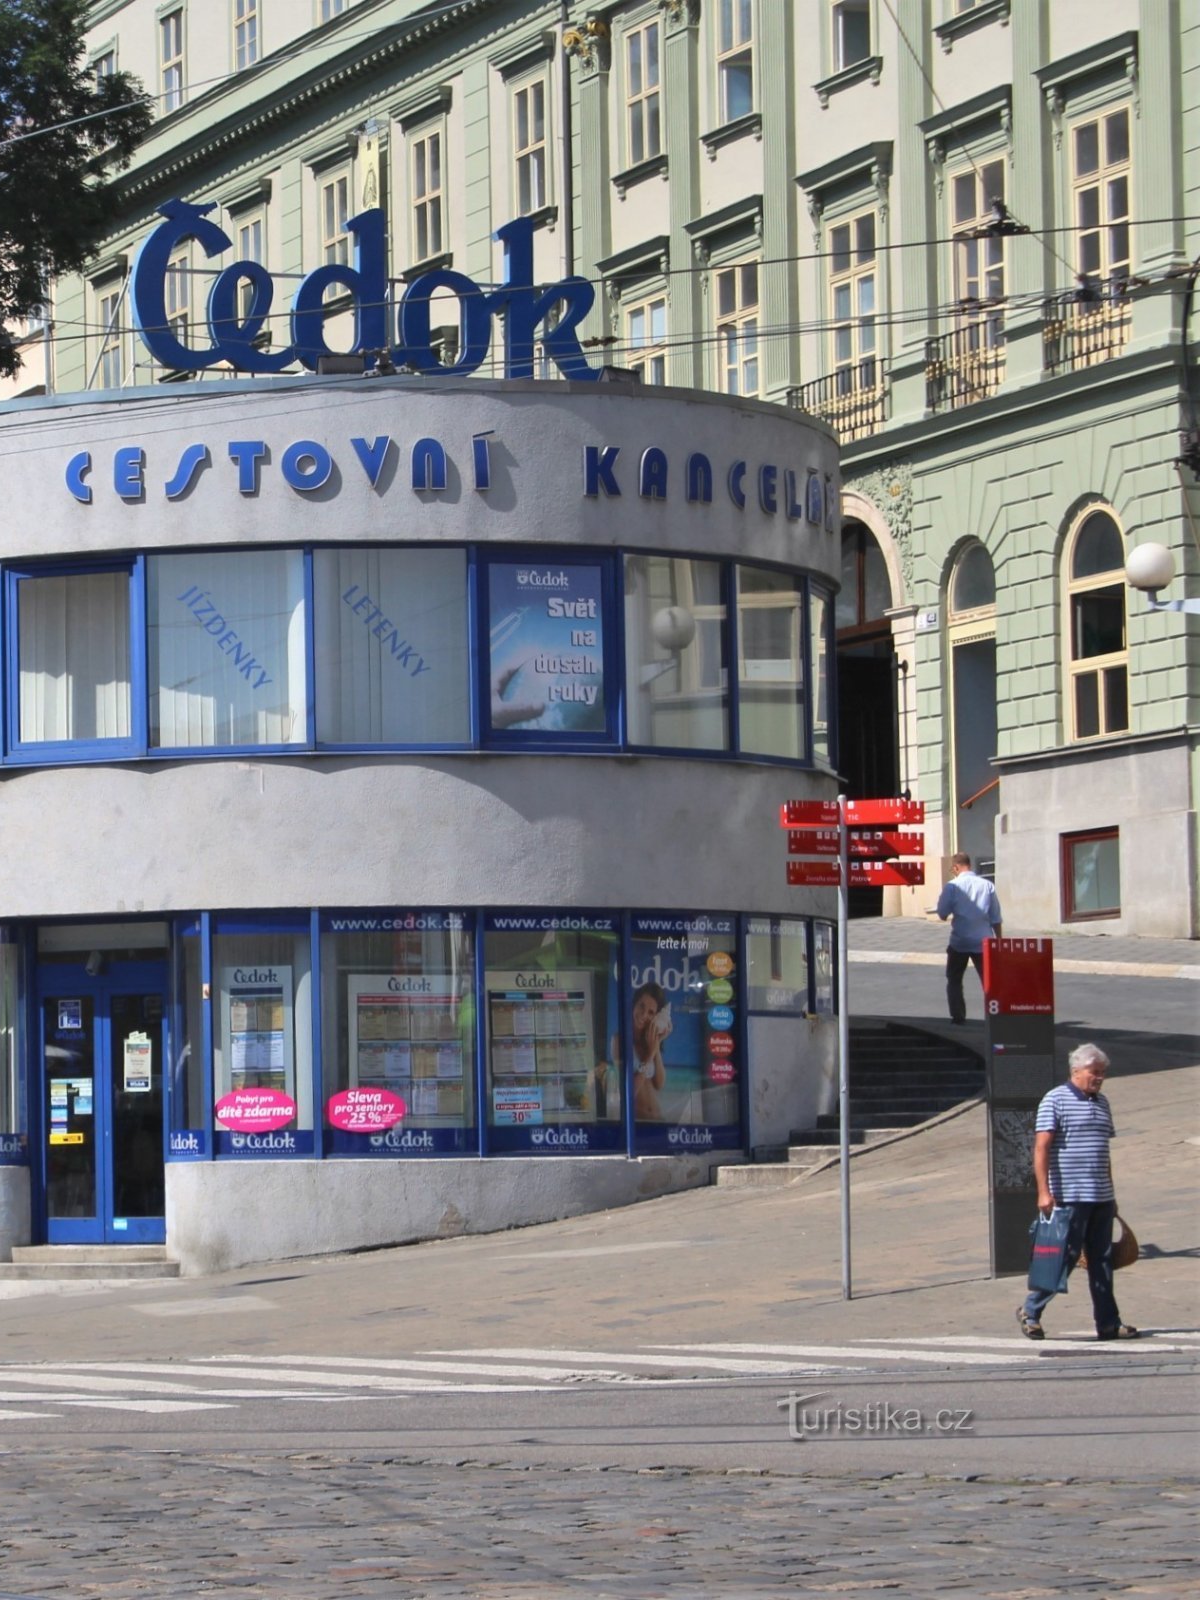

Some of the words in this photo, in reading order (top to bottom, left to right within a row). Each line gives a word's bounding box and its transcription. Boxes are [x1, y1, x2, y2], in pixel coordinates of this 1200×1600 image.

[131, 198, 605, 381] Čedok
[65, 430, 496, 502] CESTOVNÍ
[530, 570, 569, 586] Čedok
[548, 597, 597, 618] Svět
[177, 585, 273, 690] JÍZDENKY
[342, 585, 431, 678] LETENKY
[572, 629, 596, 647] na
[535, 654, 596, 675] dosah
[550, 684, 597, 705] ruky
[331, 916, 464, 931] www.cedok.cz
[494, 917, 612, 930] www.cedok.cz
[638, 917, 731, 932] www.cedok.cz
[680, 937, 688, 950] k
[234, 968, 279, 984] Čedok
[515, 973, 556, 988] Čedok
[630, 954, 701, 993] edok
[388, 976, 432, 992] Čedok
[989, 1000, 999, 1015] 8
[235, 1094, 259, 1105] Pobyt
[259, 1095, 274, 1104] pro
[347, 1090, 382, 1104] Sleva
[218, 1104, 243, 1119] dítě
[243, 1105, 293, 1118] zdarma
[334, 1104, 353, 1115] pro
[355, 1102, 395, 1114] seniory
[350, 1112, 367, 1123] 25
[246, 1131, 297, 1149] Čedok
[385, 1130, 434, 1147] Čedok
[545, 1128, 589, 1145] Čedok
[680, 1128, 713, 1144] Čedok
